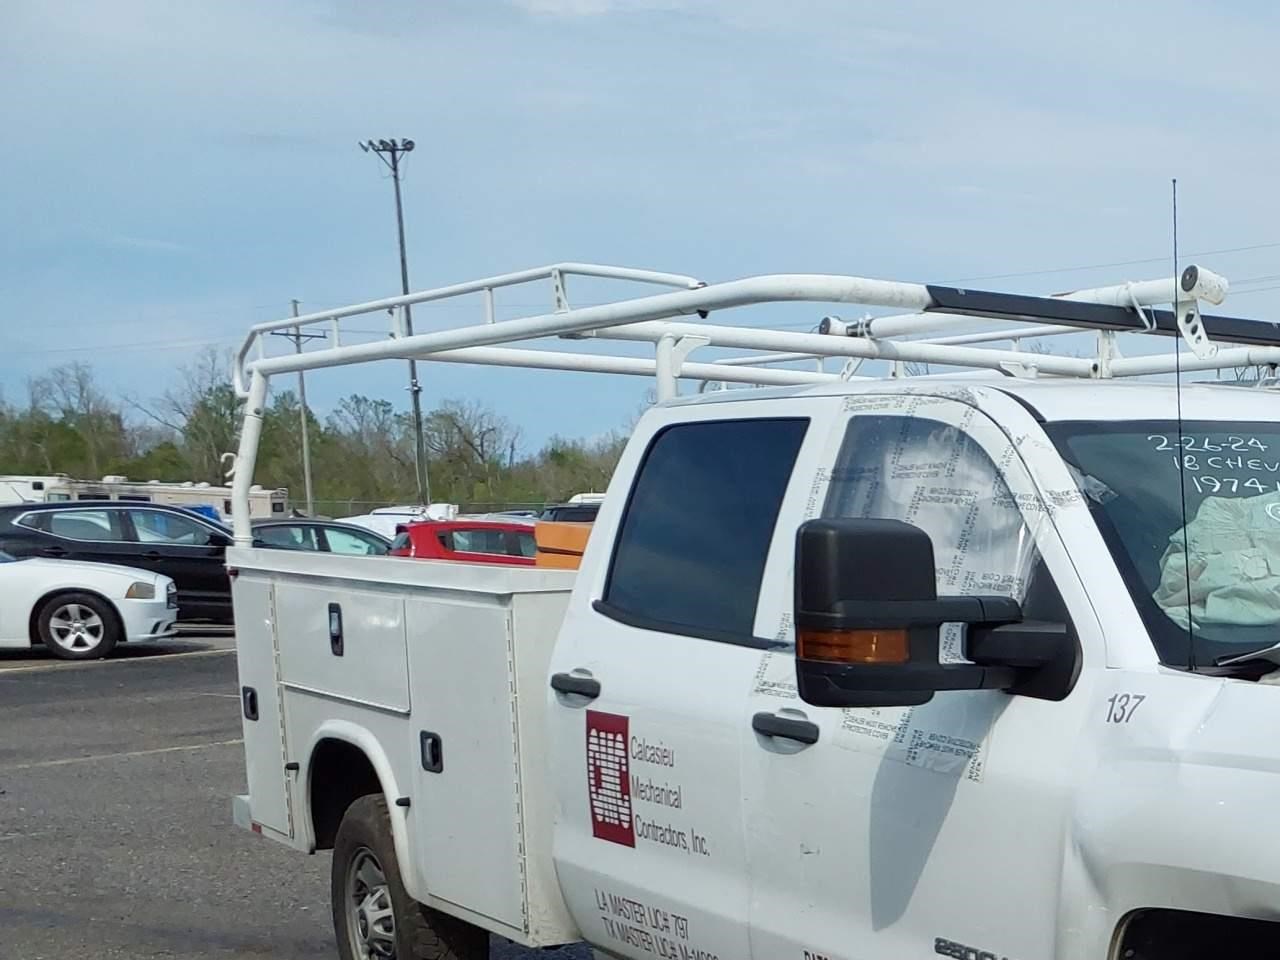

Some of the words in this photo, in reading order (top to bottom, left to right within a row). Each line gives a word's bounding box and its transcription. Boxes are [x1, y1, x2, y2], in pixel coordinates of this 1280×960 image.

[1147, 434, 1268, 452] 2-26-24
[1107, 693, 1146, 723] 137
[630, 735, 675, 768] Calcasieu
[631, 775, 682, 809] Mechanical
[635, 814, 690, 854] Contractors,
[691, 828, 711, 857] Inc.
[594, 891, 610, 912] LA
[608, 893, 648, 927] MASTER
[647, 906, 671, 932] LIC#
[671, 913, 689, 940] 797
[601, 916, 617, 939] TX
[615, 921, 657, 954] MASTER
[655, 935, 679, 960] LIC#
